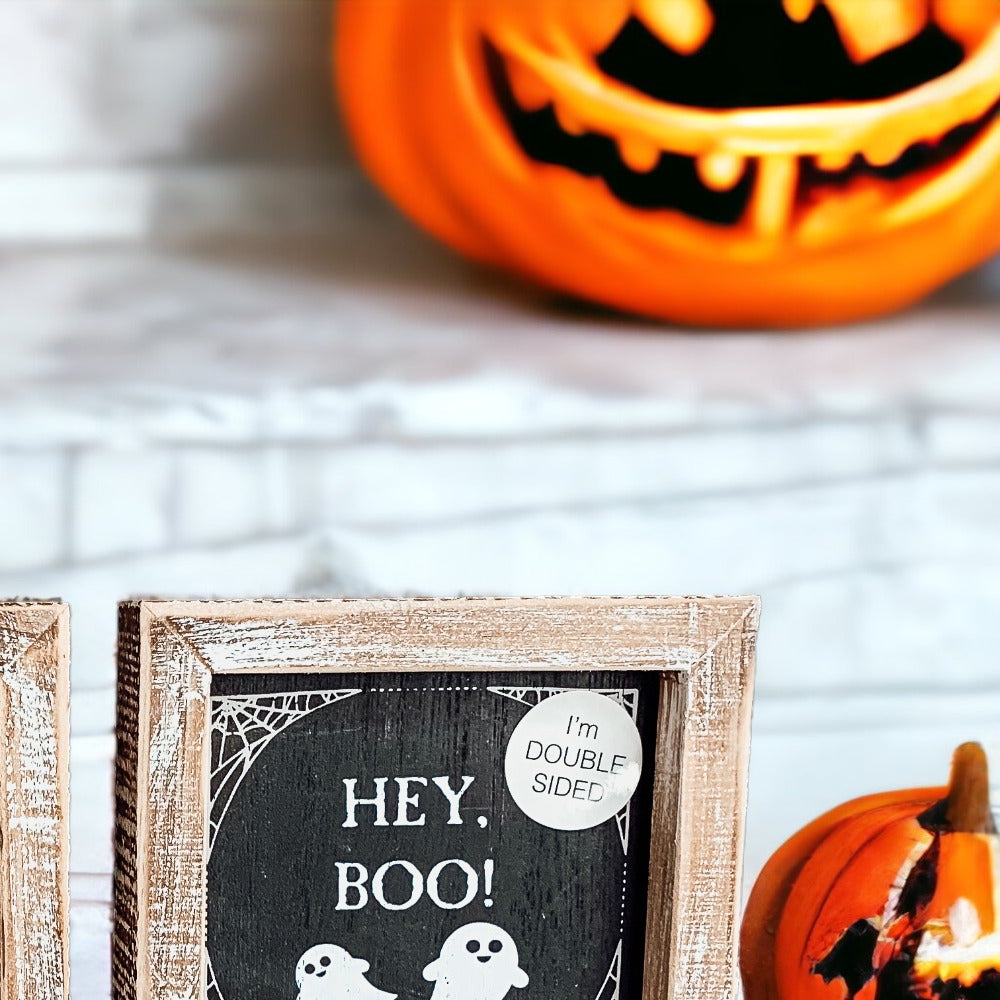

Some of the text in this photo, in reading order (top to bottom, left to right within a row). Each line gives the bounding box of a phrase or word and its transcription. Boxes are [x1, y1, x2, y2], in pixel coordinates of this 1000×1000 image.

[526, 740, 627, 776] DOUBLE
[341, 775, 489, 829] HEY,
[531, 772, 604, 802] SIDED
[334, 859, 495, 911] BOO!
